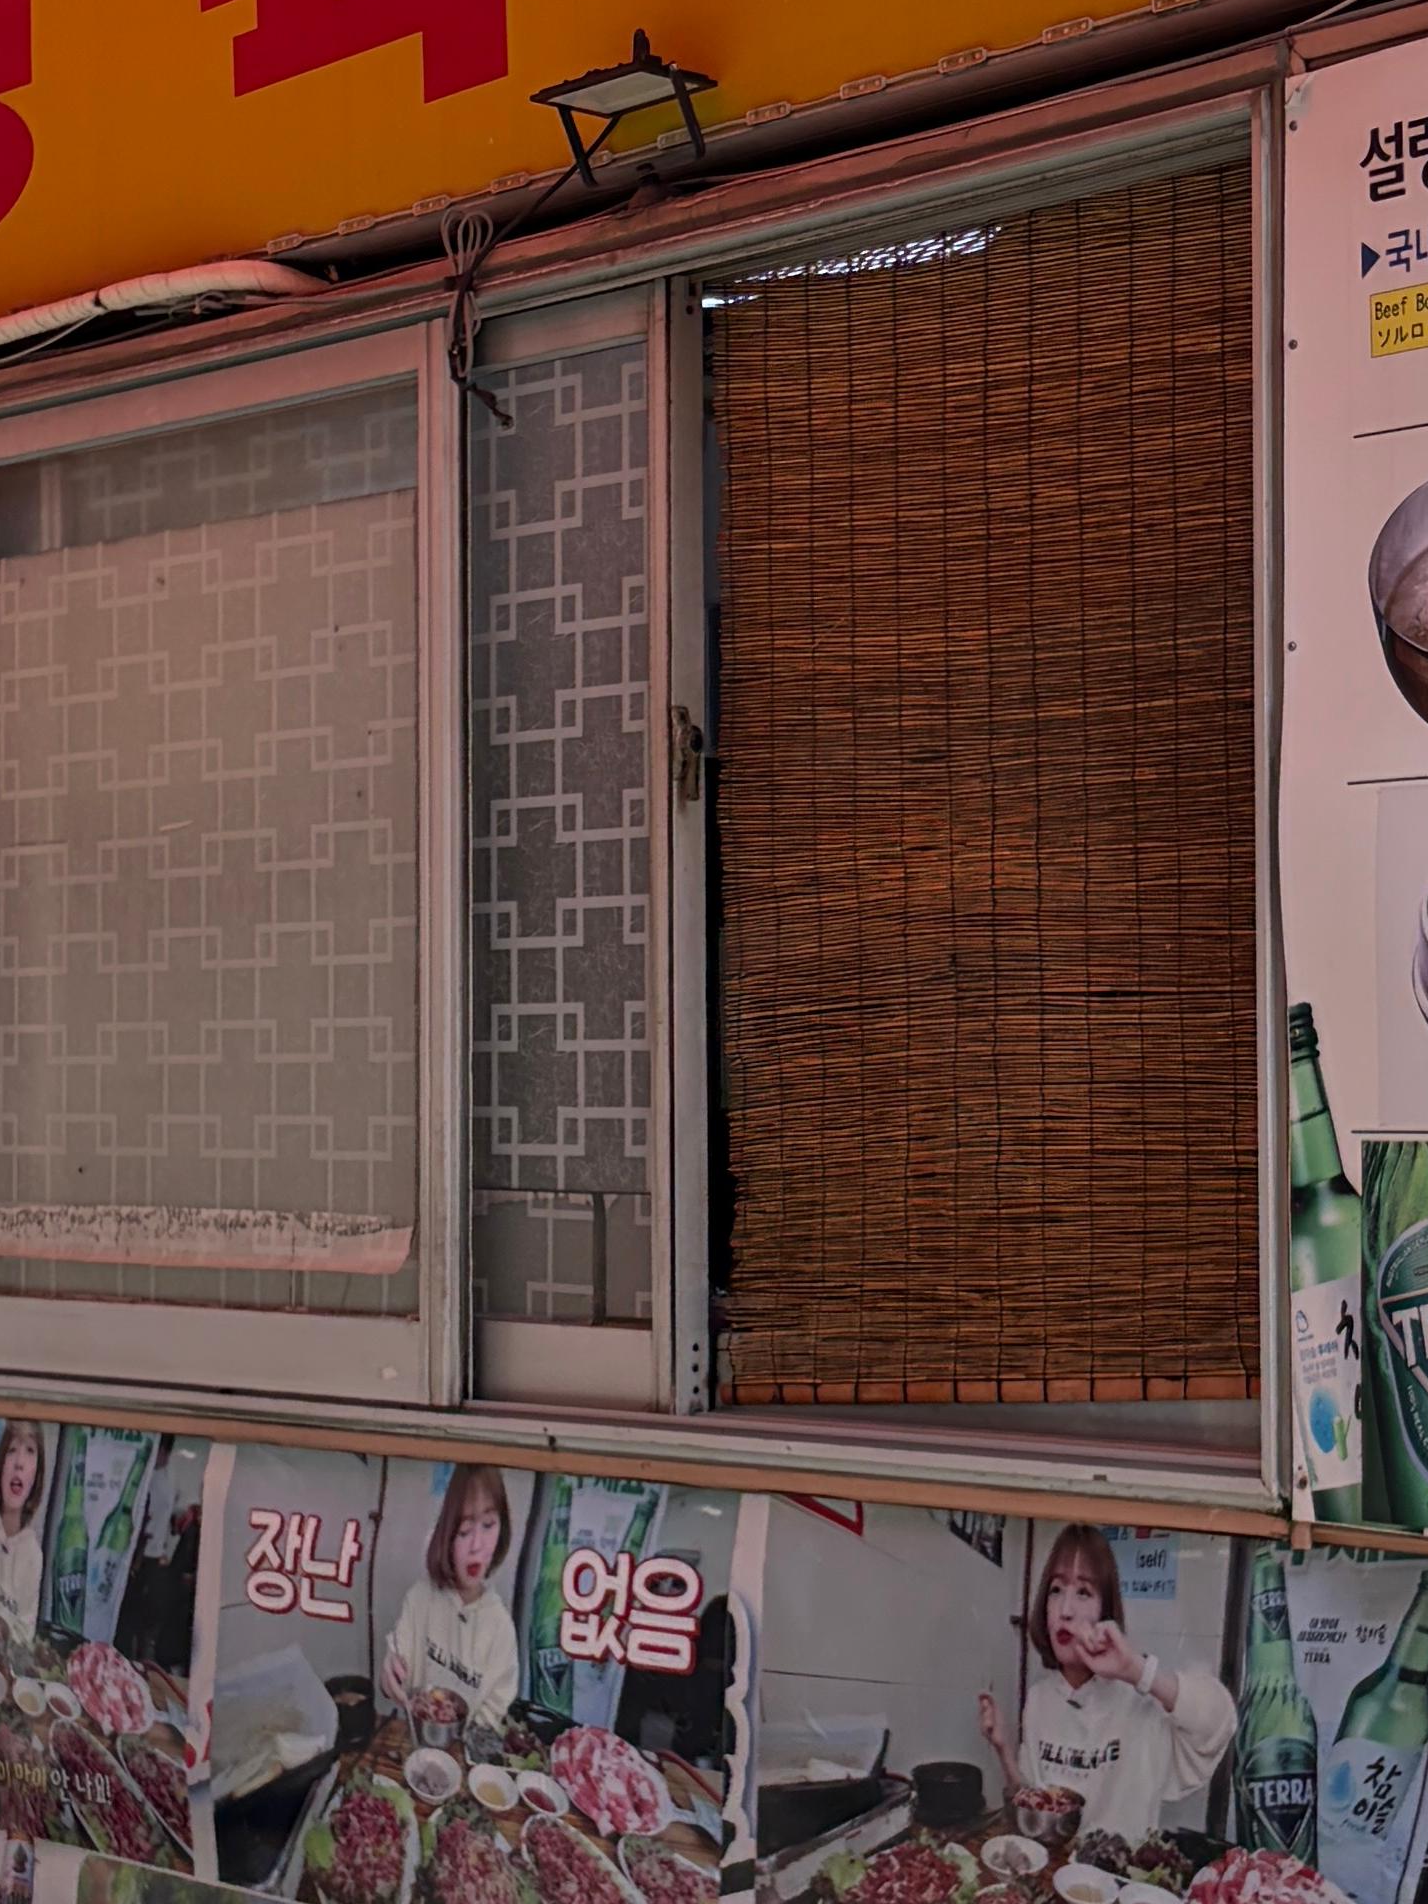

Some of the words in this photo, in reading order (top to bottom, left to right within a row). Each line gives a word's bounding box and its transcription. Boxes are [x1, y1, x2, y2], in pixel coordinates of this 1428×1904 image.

[1374, 296, 1408, 322] Beef
[245, 1508, 363, 1623] 장난
[559, 1546, 704, 1676] 없음
[49, 1767, 72, 1803] 안
[1249, 1777, 1315, 1810] TERRA
